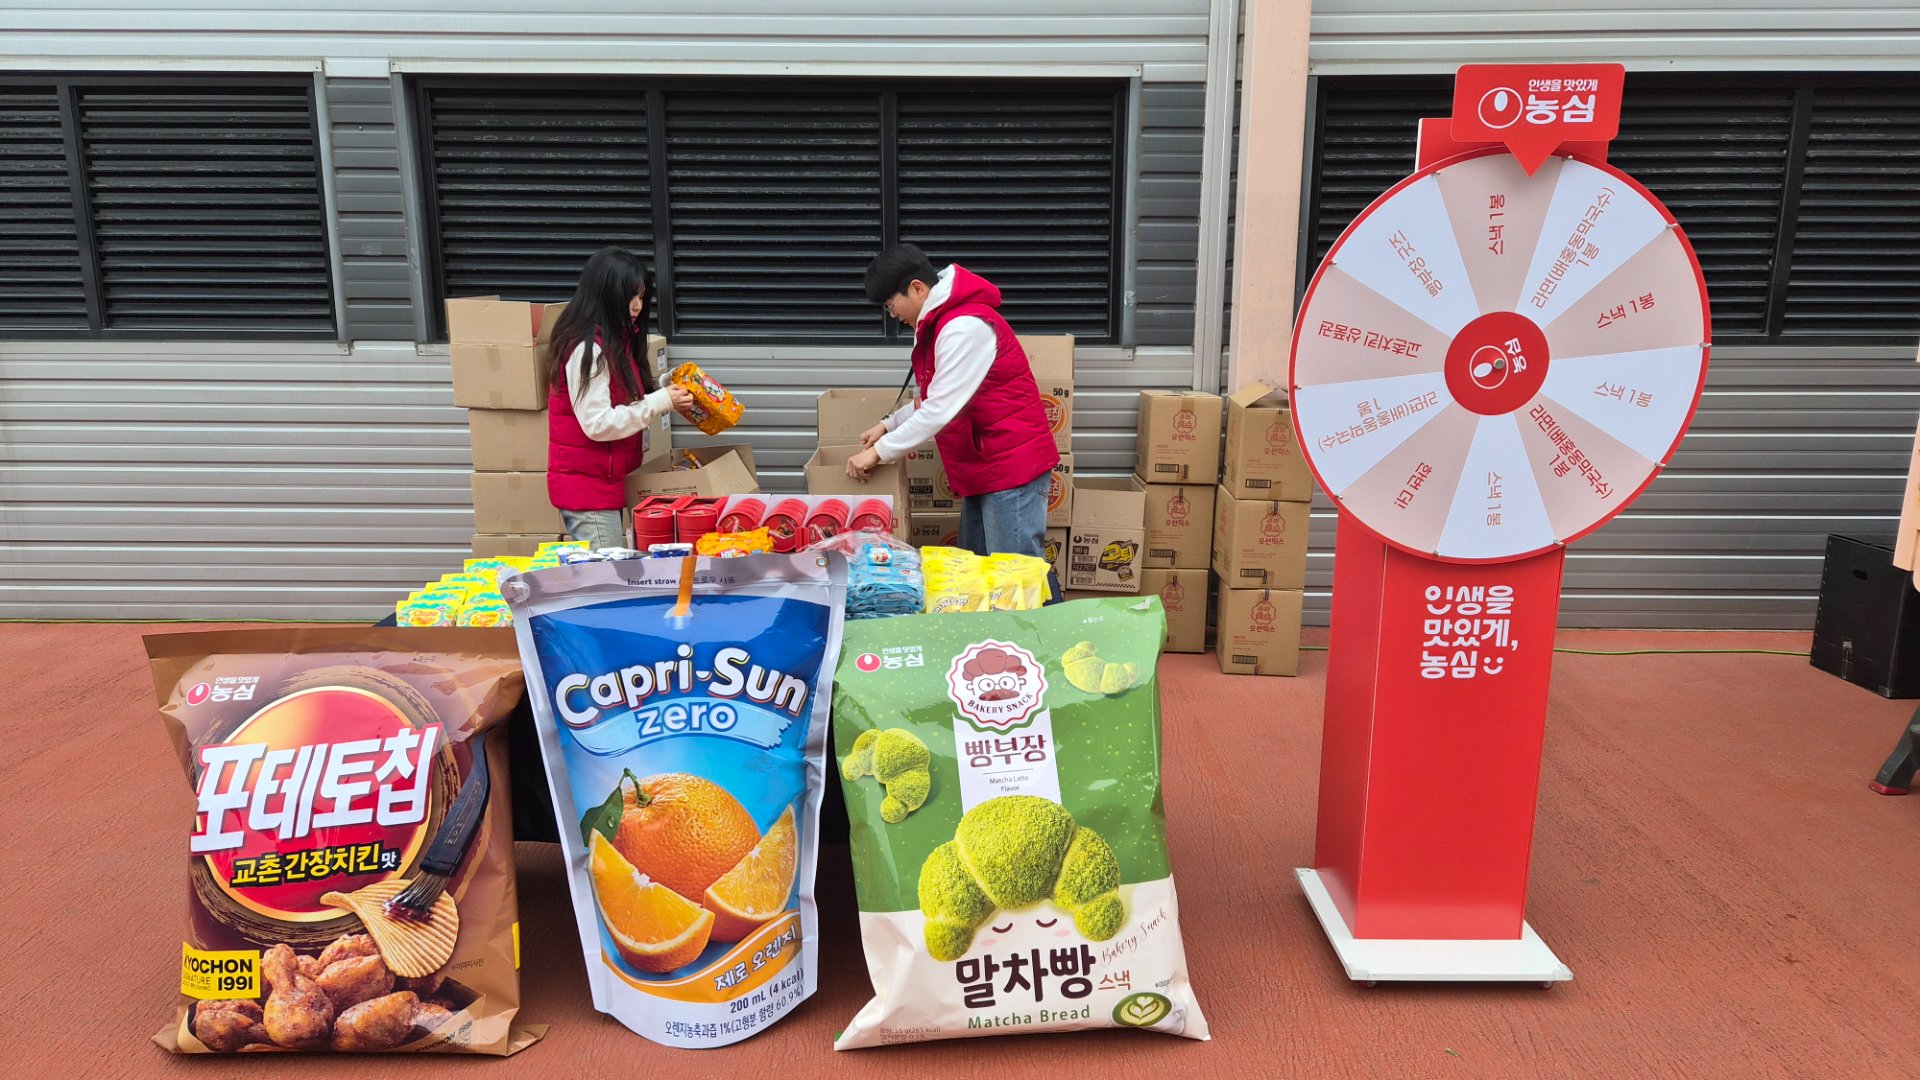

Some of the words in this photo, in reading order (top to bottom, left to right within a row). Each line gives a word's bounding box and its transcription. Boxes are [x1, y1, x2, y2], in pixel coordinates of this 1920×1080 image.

[1528, 79, 1562, 92] 인생을
[1563, 79, 1599, 92] 맛있게
[1525, 94, 1596, 125] 농심
[1489, 193, 1505, 220] 1봉
[1387, 229, 1416, 260] 굿즈
[1489, 225, 1505, 255] 스낵
[1530, 187, 1616, 309] 라면(배홍동막국수)
[1407, 256, 1444, 298] 빵부장
[1596, 303, 1627, 329] 스낵
[1628, 292, 1655, 314] 1봉
[1318, 320, 1362, 344] 상품권
[1363, 331, 1423, 359] 교촌치킨
[1504, 337, 1528, 374] 농심
[1053, 388, 1064, 396] 50
[1064, 389, 1070, 398] g
[1593, 381, 1626, 401] 스낵
[1628, 389, 1653, 408] 1봉
[1317, 390, 1439, 453] 라면(배홍동막국수)
[1529, 404, 1614, 500] 라면(배홍동막국수)
[1406, 462, 1433, 491] 한번
[1487, 471, 1503, 499] 스낵
[1394, 489, 1415, 509] 더!
[1486, 503, 1502, 527] 1봉
[628, 577, 652, 586] Insert
[654, 577, 676, 585] straw
[1165, 604, 1185, 612] 션믹스
[1425, 585, 1515, 616] 인생을
[1423, 619, 1519, 652] 맛있게,
[882, 653, 924, 670] 농심
[1420, 650, 1478, 680] 농심
[210, 684, 256, 702] 농심
[555, 644, 808, 726] Capri-Sun
[967, 700, 1004, 714] BAKERY
[1006, 692, 1034, 712] SNACK
[637, 702, 738, 739] zero
[965, 735, 1047, 768] 빵부장
[191, 726, 439, 852] 포테토칩
[989, 775, 1012, 784] Matcha
[1013, 774, 1029, 782] Latte
[232, 854, 281, 884] 교촌
[1101, 936, 1138, 968] Bakery
[1141, 907, 1167, 941] Snack
[714, 961, 750, 991] 제로
[752, 924, 798, 972] 오렌지
[218, 976, 253, 991] 1991
[730, 1001, 749, 1014] 200
[752, 992, 767, 1006] mL
[769, 984, 779, 998] (4
[781, 968, 804, 988] kcal)
[956, 944, 1096, 1009] 말차빵
[1098, 970, 1131, 991] 스낵
[759, 1003, 774, 1022] 함량
[776, 985, 804, 1012] 60.9%)
[968, 1013, 1033, 1030] Matcha
[1040, 1005, 1090, 1023] Bread
